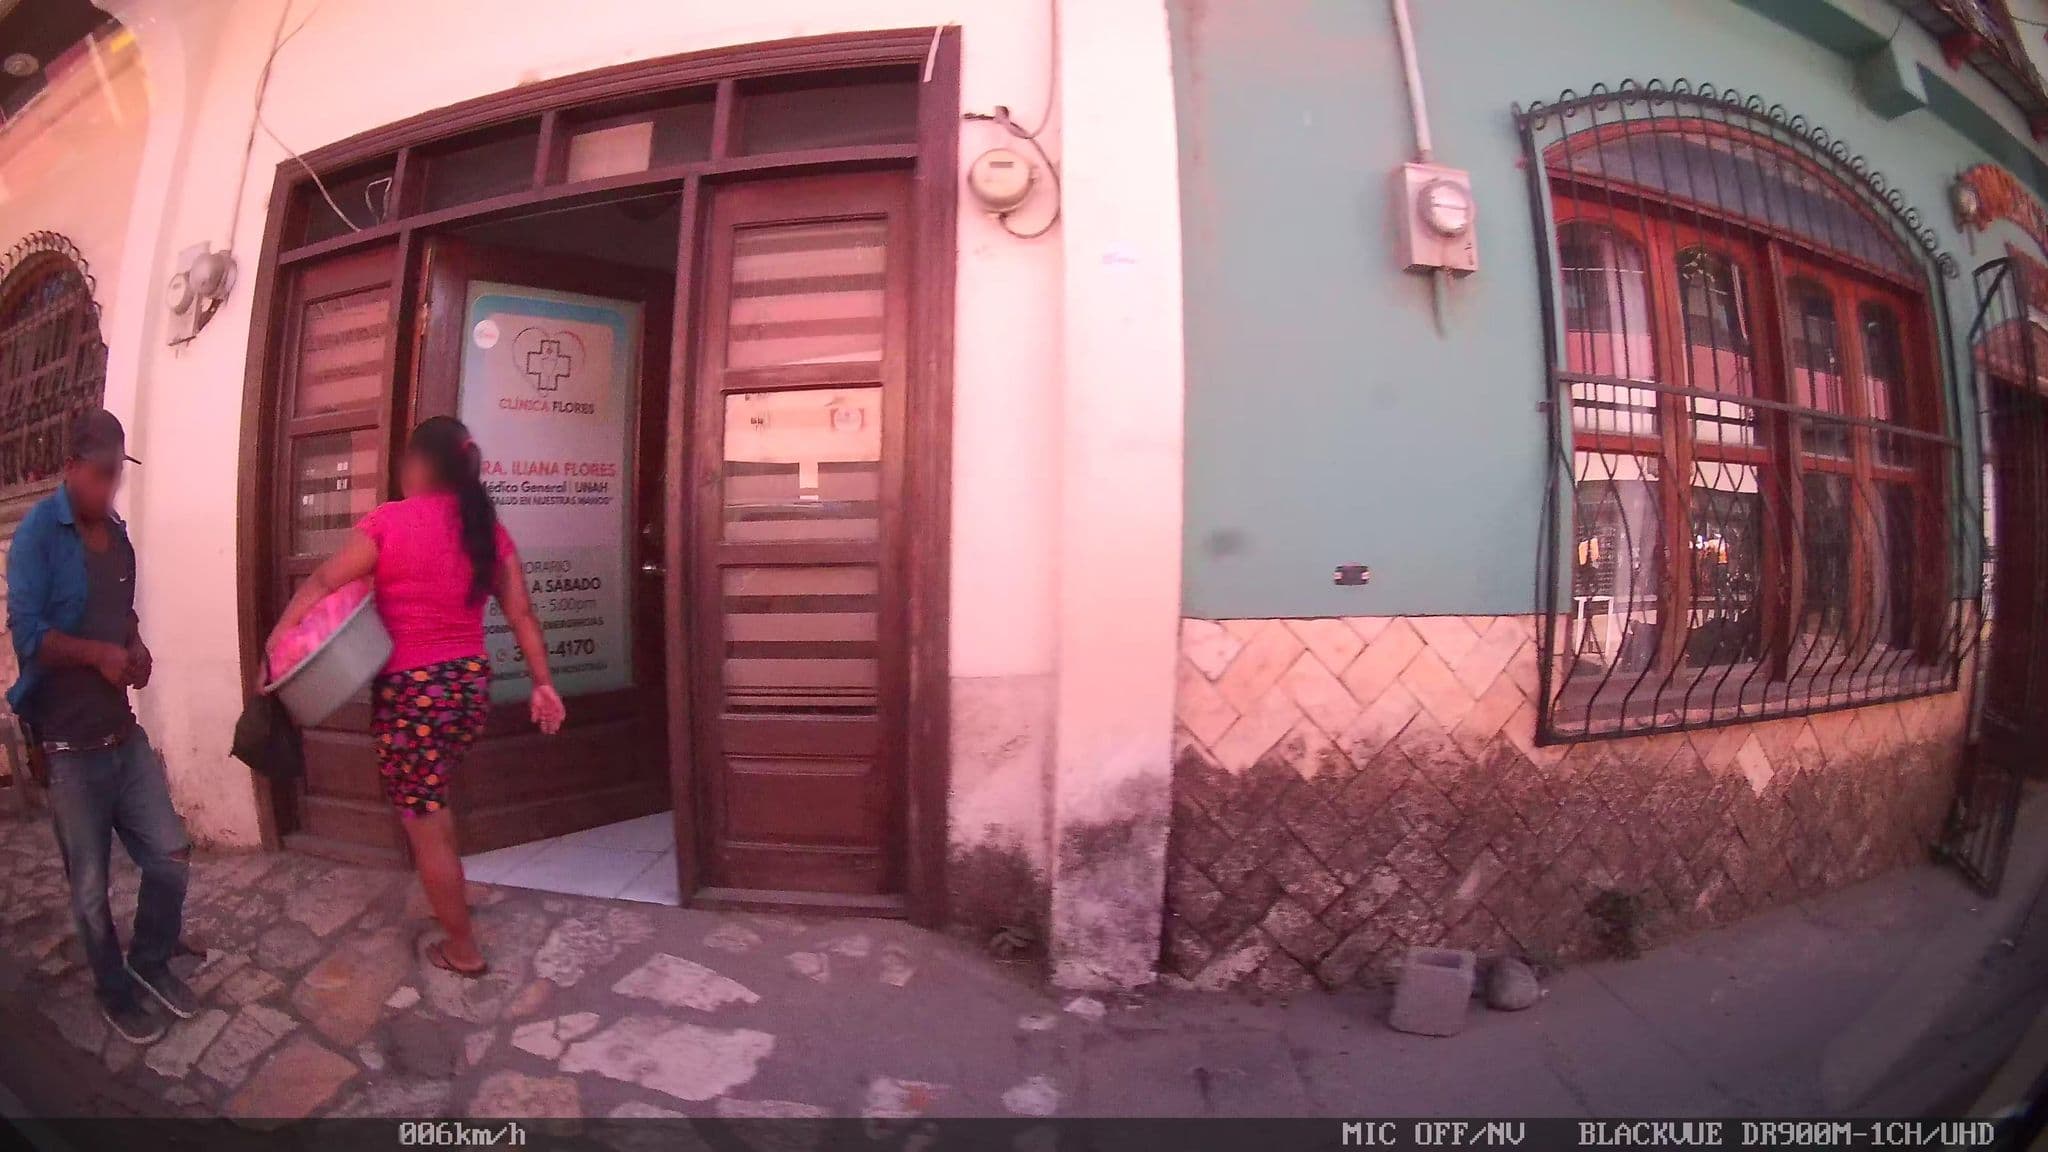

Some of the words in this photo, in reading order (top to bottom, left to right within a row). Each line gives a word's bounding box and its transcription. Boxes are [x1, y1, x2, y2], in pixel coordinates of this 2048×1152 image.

[498, 396, 548, 412] CLÍNICA
[552, 401, 595, 414] FLORES
[480, 460, 507, 475] RA.
[512, 461, 560, 476] ILIANA
[564, 462, 616, 477] FLORES
[521, 481, 567, 493] General
[575, 482, 608, 493] UNAH
[534, 496, 576, 505] NUESTRAS
[520, 560, 571, 574] ORARIO
[531, 580, 543, 593] A
